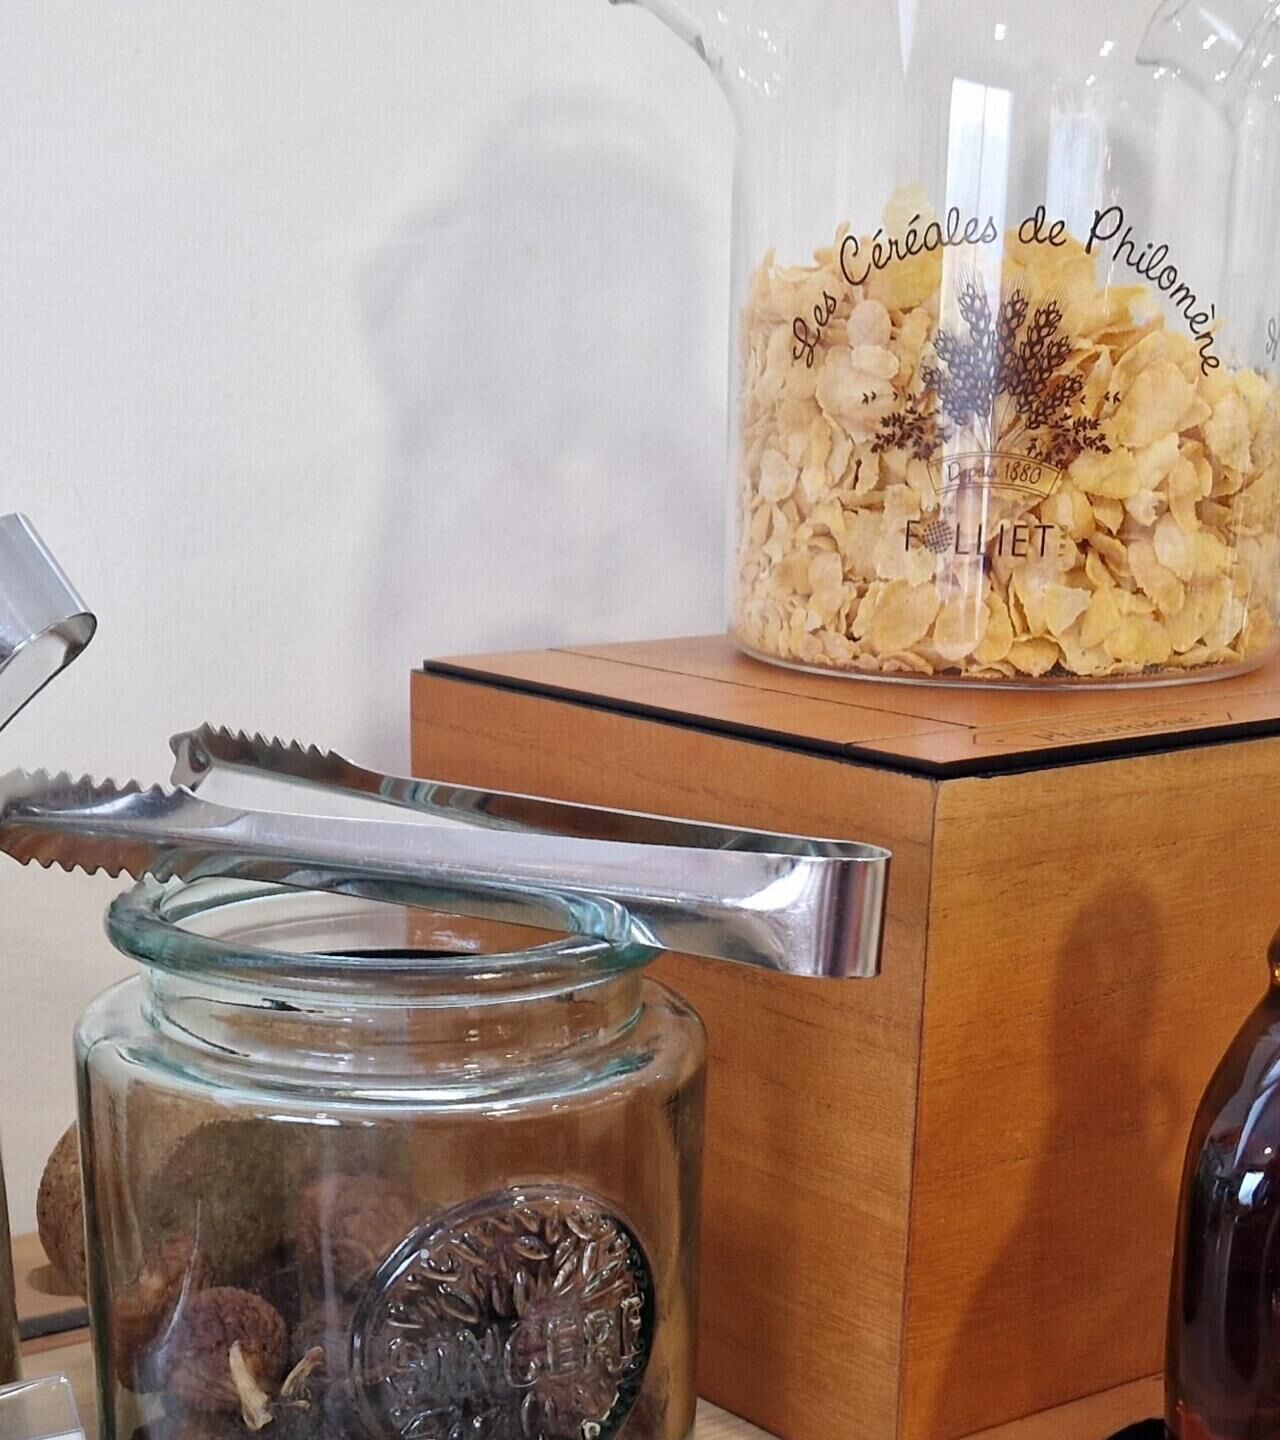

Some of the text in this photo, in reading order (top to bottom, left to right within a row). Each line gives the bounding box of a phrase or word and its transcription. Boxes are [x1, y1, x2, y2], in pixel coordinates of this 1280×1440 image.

[791, 205, 1220, 377] Les Céréales de Philomène
[1005, 460, 1042, 485] 1880
